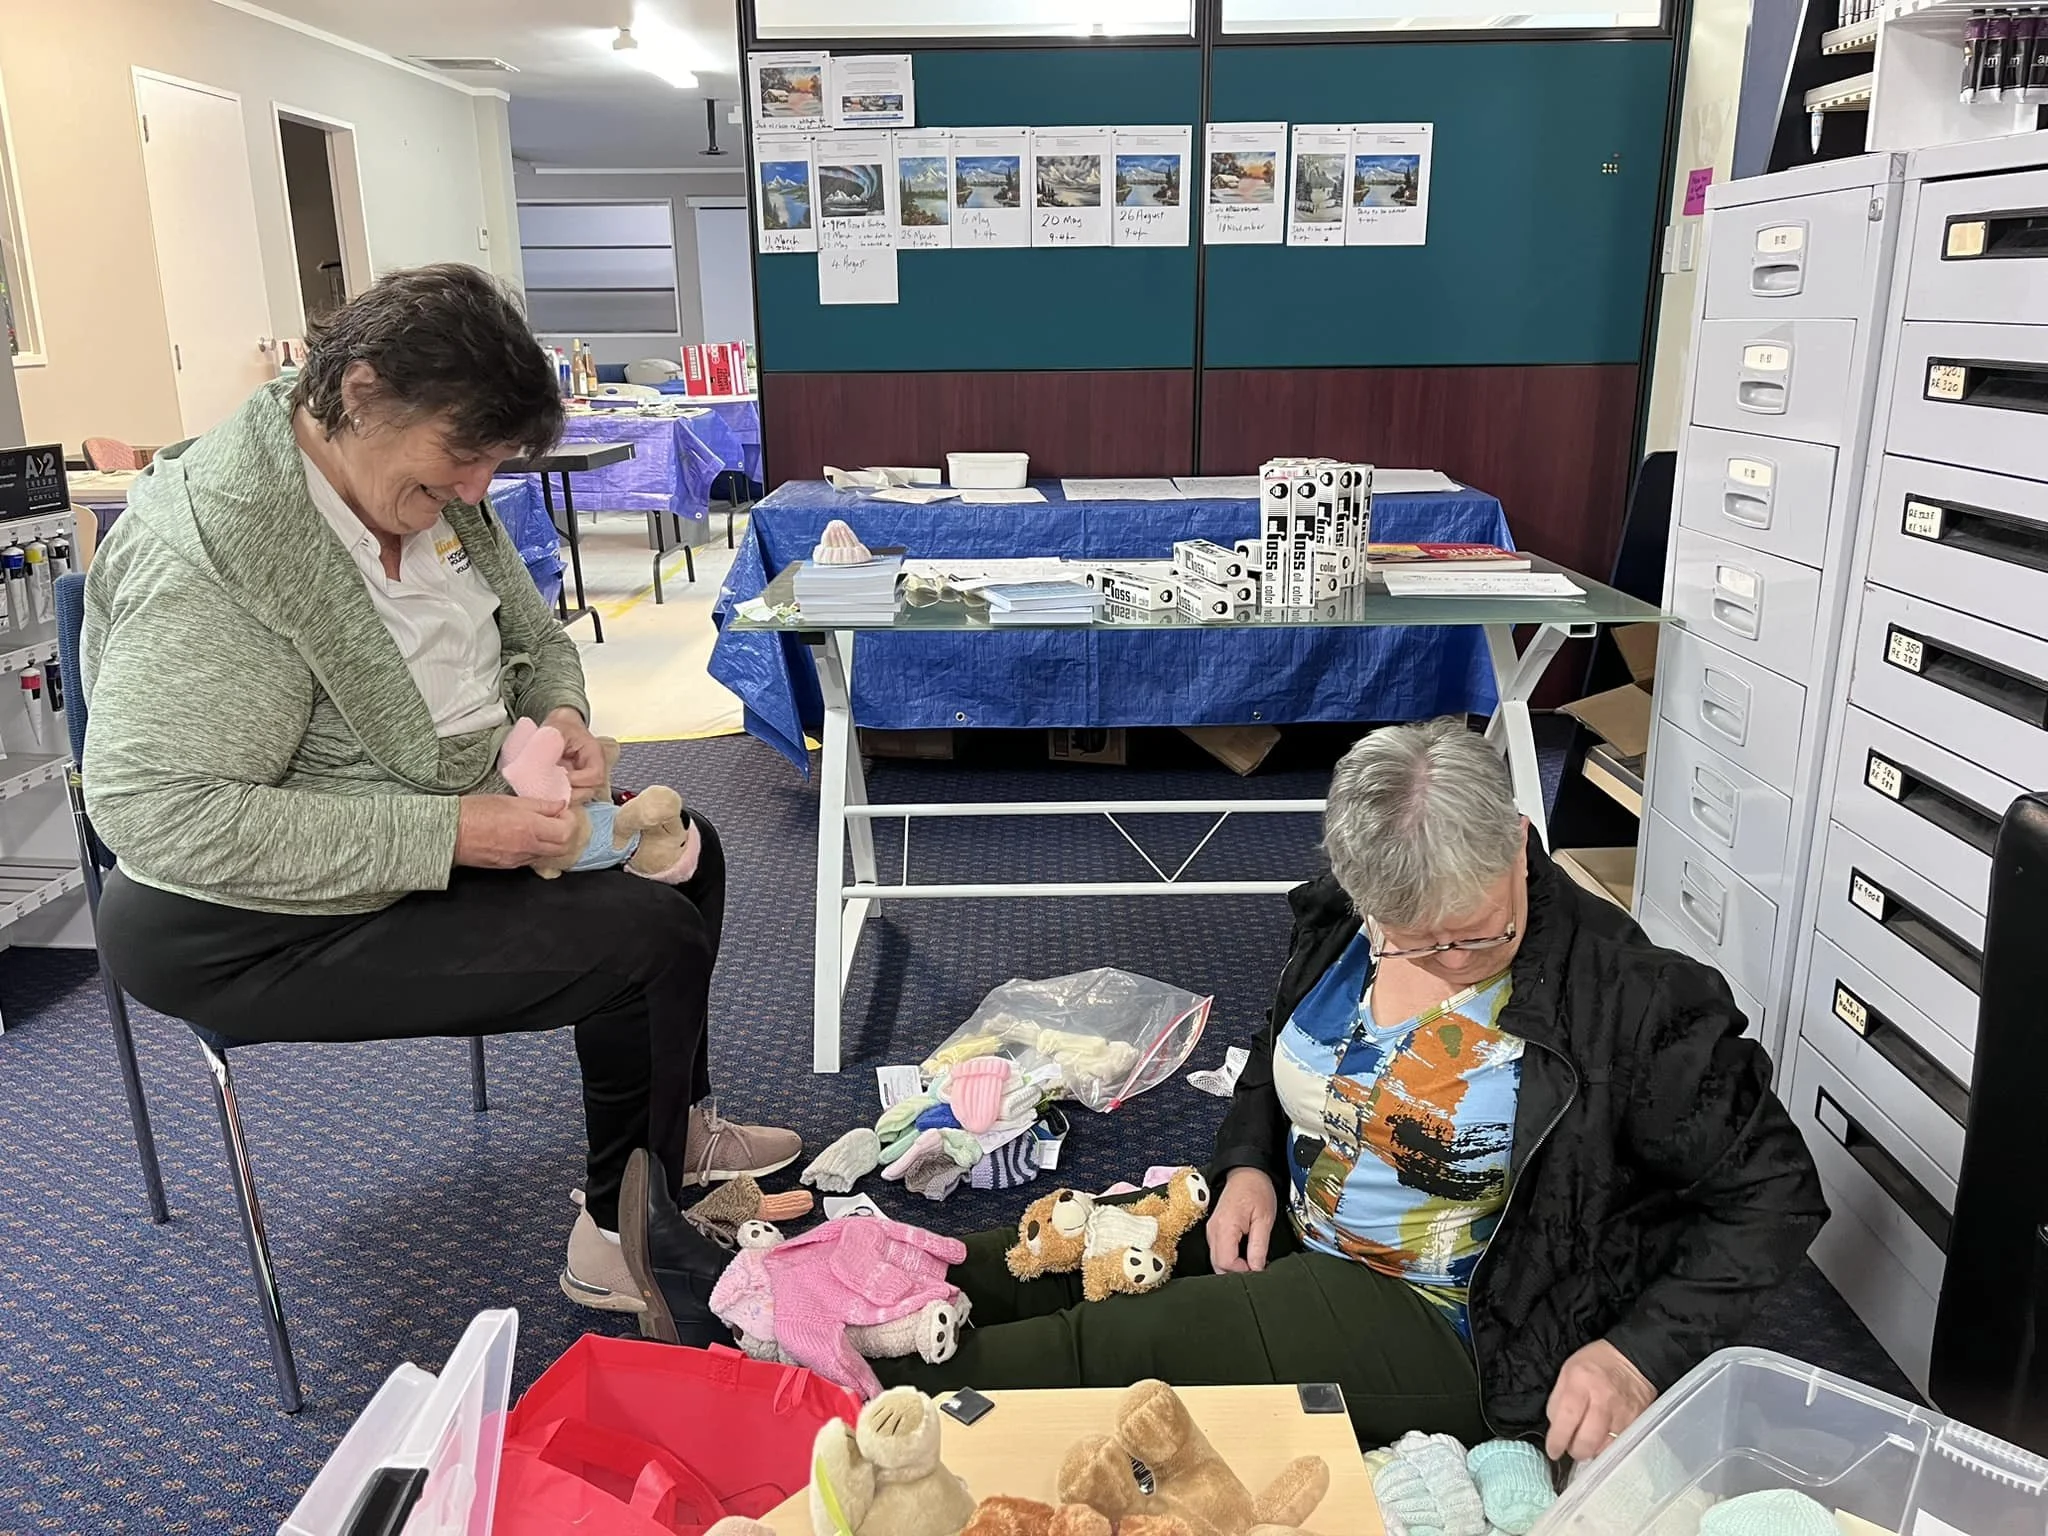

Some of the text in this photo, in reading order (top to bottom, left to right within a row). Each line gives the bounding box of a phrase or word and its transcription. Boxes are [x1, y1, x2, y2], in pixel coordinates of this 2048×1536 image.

[1041, 213, 1082, 228] 20 May
[1136, 209, 1164, 224] August
[843, 253, 867, 274] August
[1266, 516, 1288, 570] Ross
[1293, 515, 1316, 570] Ross
[1320, 562, 1337, 573] color
[1102, 577, 1131, 602] Ross
